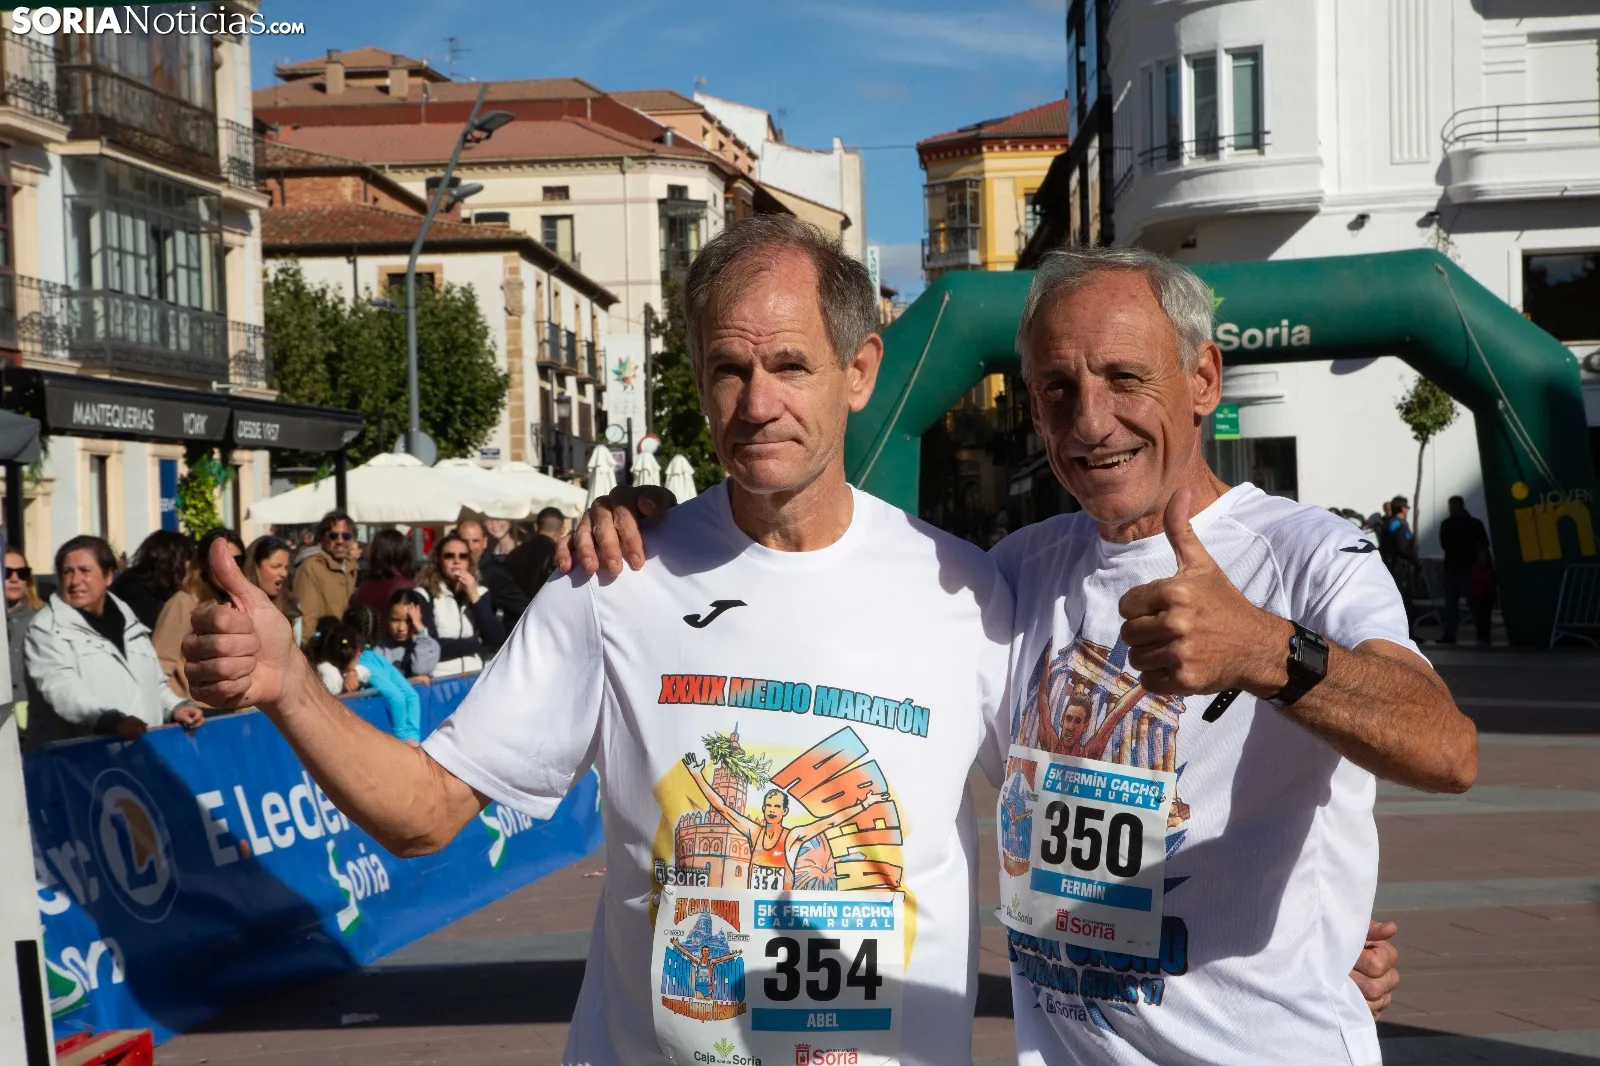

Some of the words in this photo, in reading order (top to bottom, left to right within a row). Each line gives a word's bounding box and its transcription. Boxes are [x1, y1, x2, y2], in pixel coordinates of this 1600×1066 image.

[1215, 319, 1311, 351] Soria
[73, 400, 155, 431] MANTEQUERIAS
[183, 412, 208, 435] YORK
[238, 420, 262, 439] DESDE
[658, 674, 727, 706] XXXIX
[728, 676, 812, 714] MEDIO
[813, 685, 930, 738] MARATÓN
[1045, 780, 1080, 795] CAJA
[1095, 788, 1156, 807] RURAL
[1048, 767, 1064, 780] 5K
[1064, 771, 1107, 789] FERMÍN
[1110, 778, 1160, 798] CACHO
[1040, 800, 1144, 878] 350
[326, 839, 391, 933] Soria
[667, 866, 709, 887] Soria
[754, 876, 779, 890] 354
[1060, 878, 1106, 900] FERMÍN
[674, 897, 688, 925] 5K
[711, 899, 741, 933] RURAL
[757, 904, 777, 917] 5K
[783, 902, 838, 918] FERMÍN
[842, 905, 891, 918] CACHO
[1017, 911, 1033, 926] Soria
[757, 917, 810, 927] CAJA
[827, 918, 891, 928] RURAL
[1069, 917, 1116, 941] Soria
[763, 936, 883, 1002] 354
[807, 1012, 839, 1028] ABEL
[1055, 1000, 1087, 1022] Soria
[694, 1050, 716, 1064] Caja
[732, 1054, 762, 1066] Soria
[812, 1048, 858, 1066] Soria
